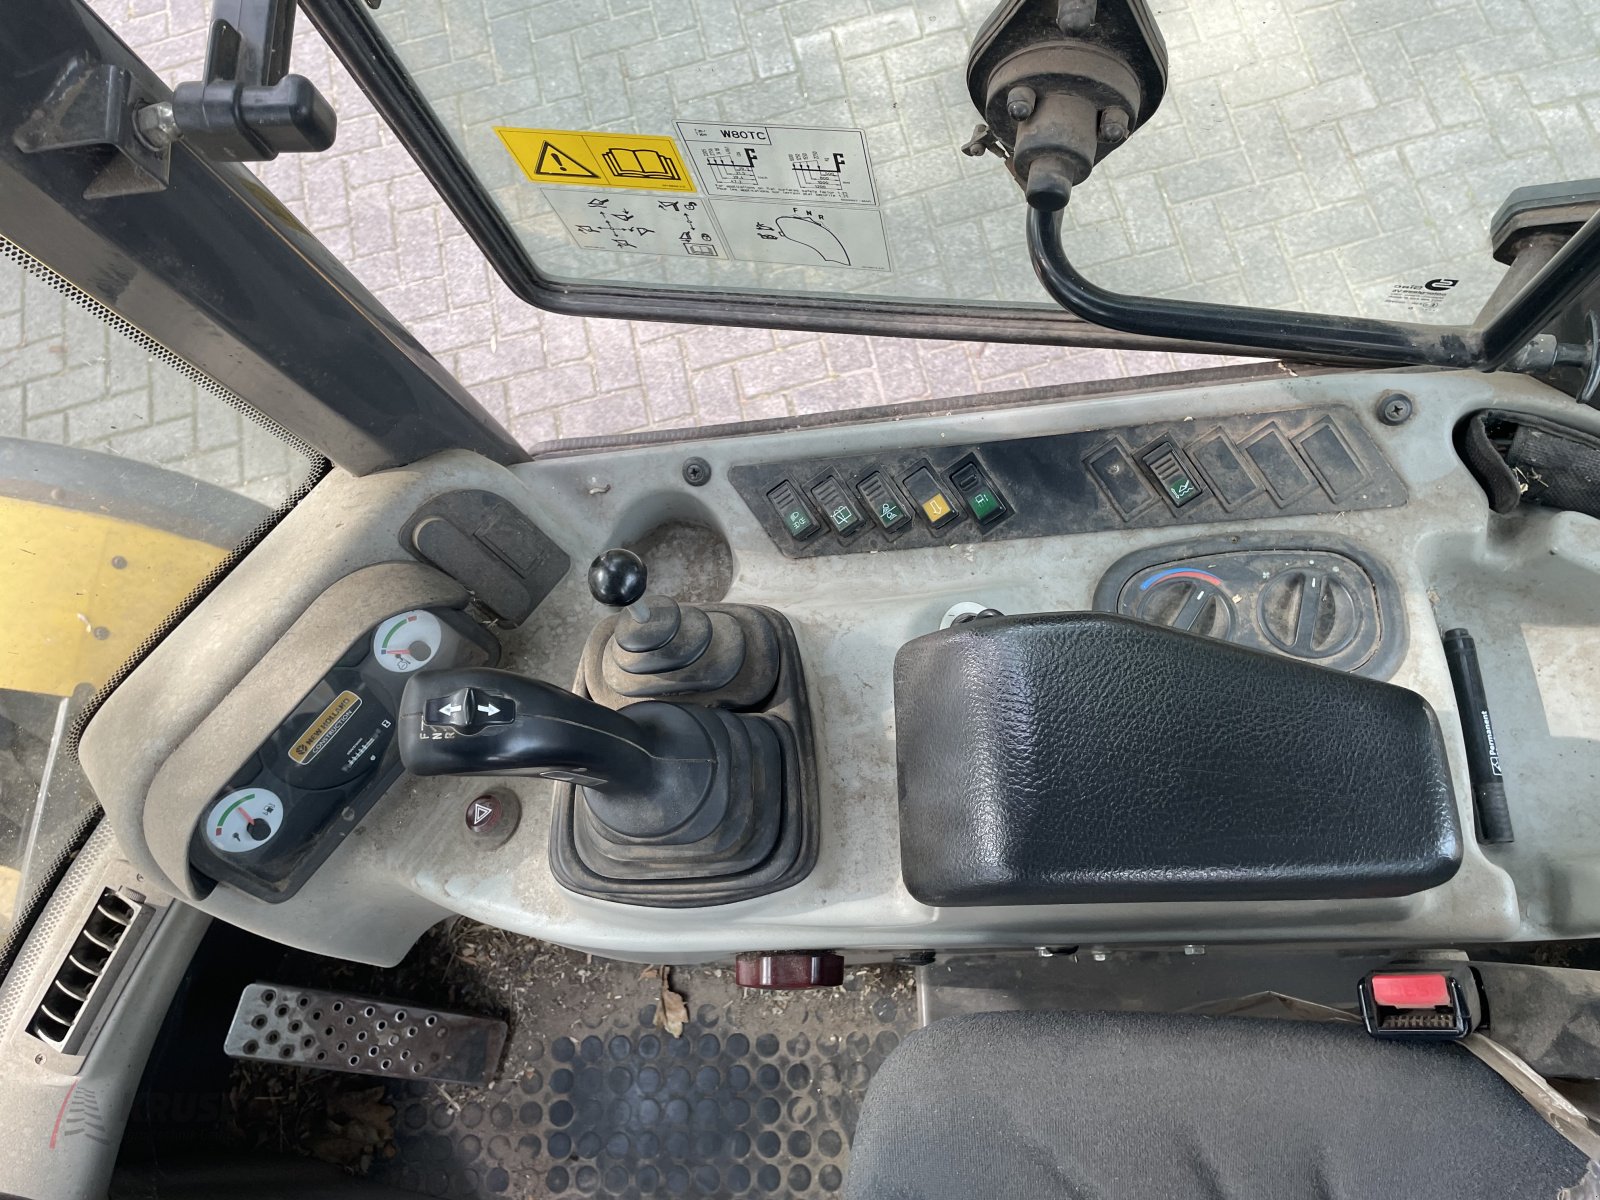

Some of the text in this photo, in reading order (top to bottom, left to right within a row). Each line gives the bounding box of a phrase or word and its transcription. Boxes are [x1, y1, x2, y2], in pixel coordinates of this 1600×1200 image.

[305, 697, 351, 746] NEW HOLLAND
[312, 709, 353, 754] CONSTRUCTION
[419, 732, 430, 740] F
[431, 732, 443, 740] N
[1481, 710, 1497, 756] Permanent
